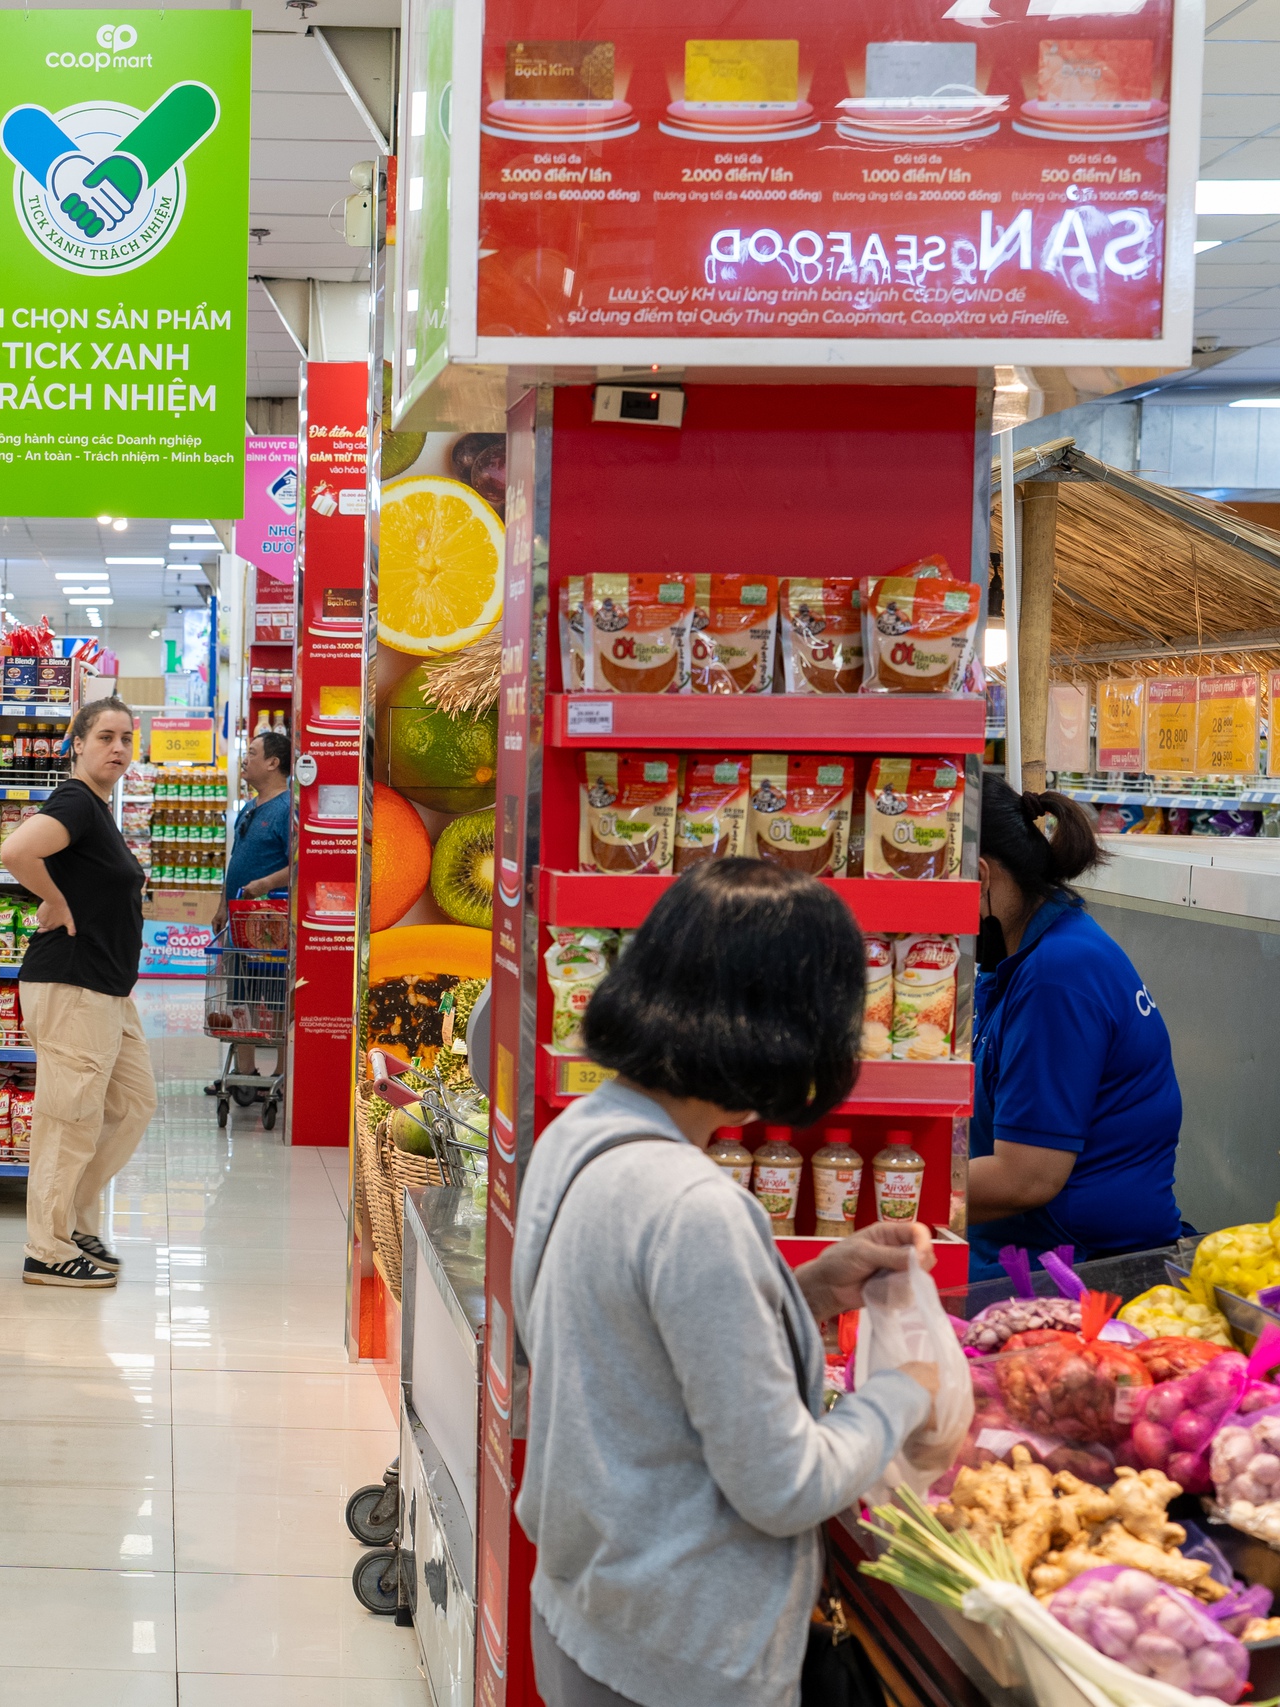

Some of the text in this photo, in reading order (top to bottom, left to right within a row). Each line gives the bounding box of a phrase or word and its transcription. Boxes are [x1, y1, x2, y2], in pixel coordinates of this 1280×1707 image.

[515, 64, 575, 79] Bạch Kim
[533, 153, 581, 165] Đổi tối đa
[714, 153, 762, 165] Đổi tối đa
[894, 153, 942, 165] Đổi tối đa
[1068, 153, 1116, 165] Đổi tối đa
[501, 168, 541, 183] 3.000
[589, 168, 612, 183] lần
[682, 168, 722, 183] 2.000
[771, 168, 793, 183] lần
[862, 169, 900, 183] 1.000
[948, 168, 971, 183] lần
[1040, 169, 1068, 183] 500
[1118, 168, 1141, 183] lần
[559, 190, 605, 201] 600.000
[739, 190, 787, 201] 400.000
[919, 190, 966, 201] 200.000
[28, 194, 173, 261] TICK XANH TRÁCH NHIỆM
[608, 287, 640, 302] Lưu
[656, 287, 689, 303] Quý
[691, 288, 715, 301] KH
[718, 288, 741, 301] vui
[743, 286, 778, 304] lòng
[781, 286, 818, 302] trình
[857, 287, 898, 302] chính
[1006, 286, 1026, 302] để
[12, 308, 88, 333] CHỌN
[95, 303, 148, 329] SẢN
[157, 302, 231, 330] PHẨM
[567, 309, 588, 323] sử
[590, 310, 630, 326] dụng
[633, 307, 674, 324] điểm
[676, 309, 697, 325] tại
[700, 307, 742, 327] Quầy
[745, 310, 779, 323] Thu
[781, 309, 819, 327] ngân
[989, 309, 1008, 323] và
[1011, 309, 1070, 325] Finelife.
[2, 342, 189, 371] TICK XANH
[104, 377, 216, 418] NHIỆM
[24, 433, 54, 444] hành
[58, 433, 88, 448] cùng
[92, 434, 113, 445] các
[117, 434, 156, 446] Doanh
[159, 434, 202, 448] nghiệp
[249, 441, 290, 451] KHU VỰC
[25, 451, 41, 461] An
[43, 450, 72, 462] toàn
[83, 450, 119, 462] Trách
[121, 450, 160, 464] nhiệm
[171, 451, 201, 463] Minh
[204, 452, 234, 465] bạch
[246, 453, 267, 462] BÌNH
[310, 451, 332, 462] GIẢM
[166, 739, 199, 752] 36.900
[169, 934, 210, 947] CO.OP
